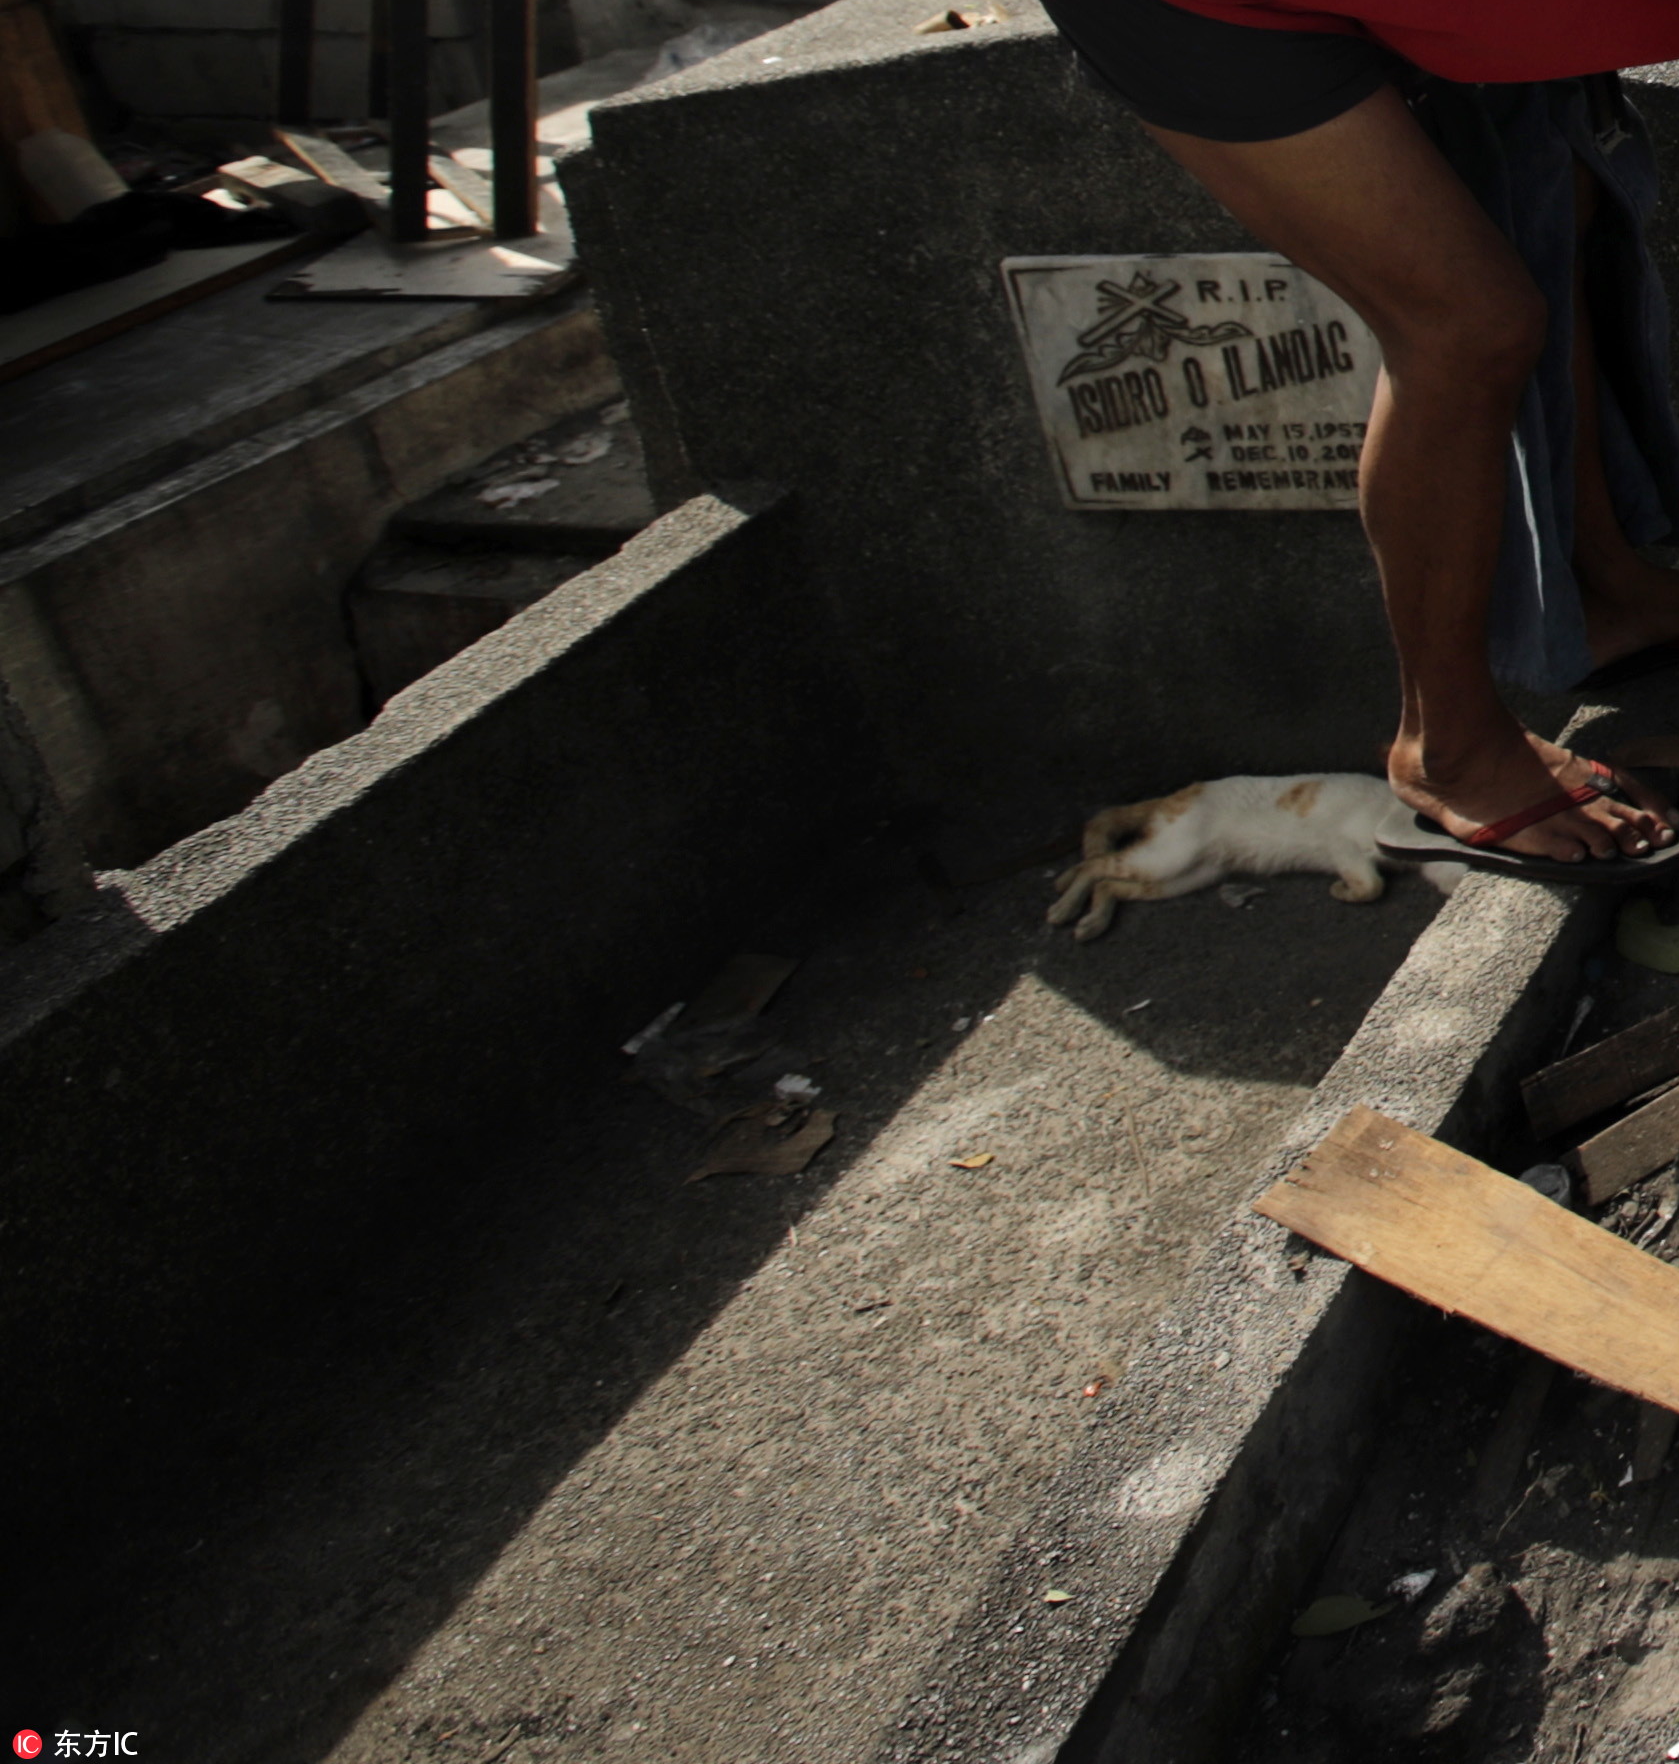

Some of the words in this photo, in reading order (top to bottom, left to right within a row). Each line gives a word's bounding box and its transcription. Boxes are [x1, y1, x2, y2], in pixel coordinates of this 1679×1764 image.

[1067, 367, 1169, 439] ISIDRO
[1223, 423, 1271, 440] MAY
[1090, 472, 1170, 492] FAMILY
